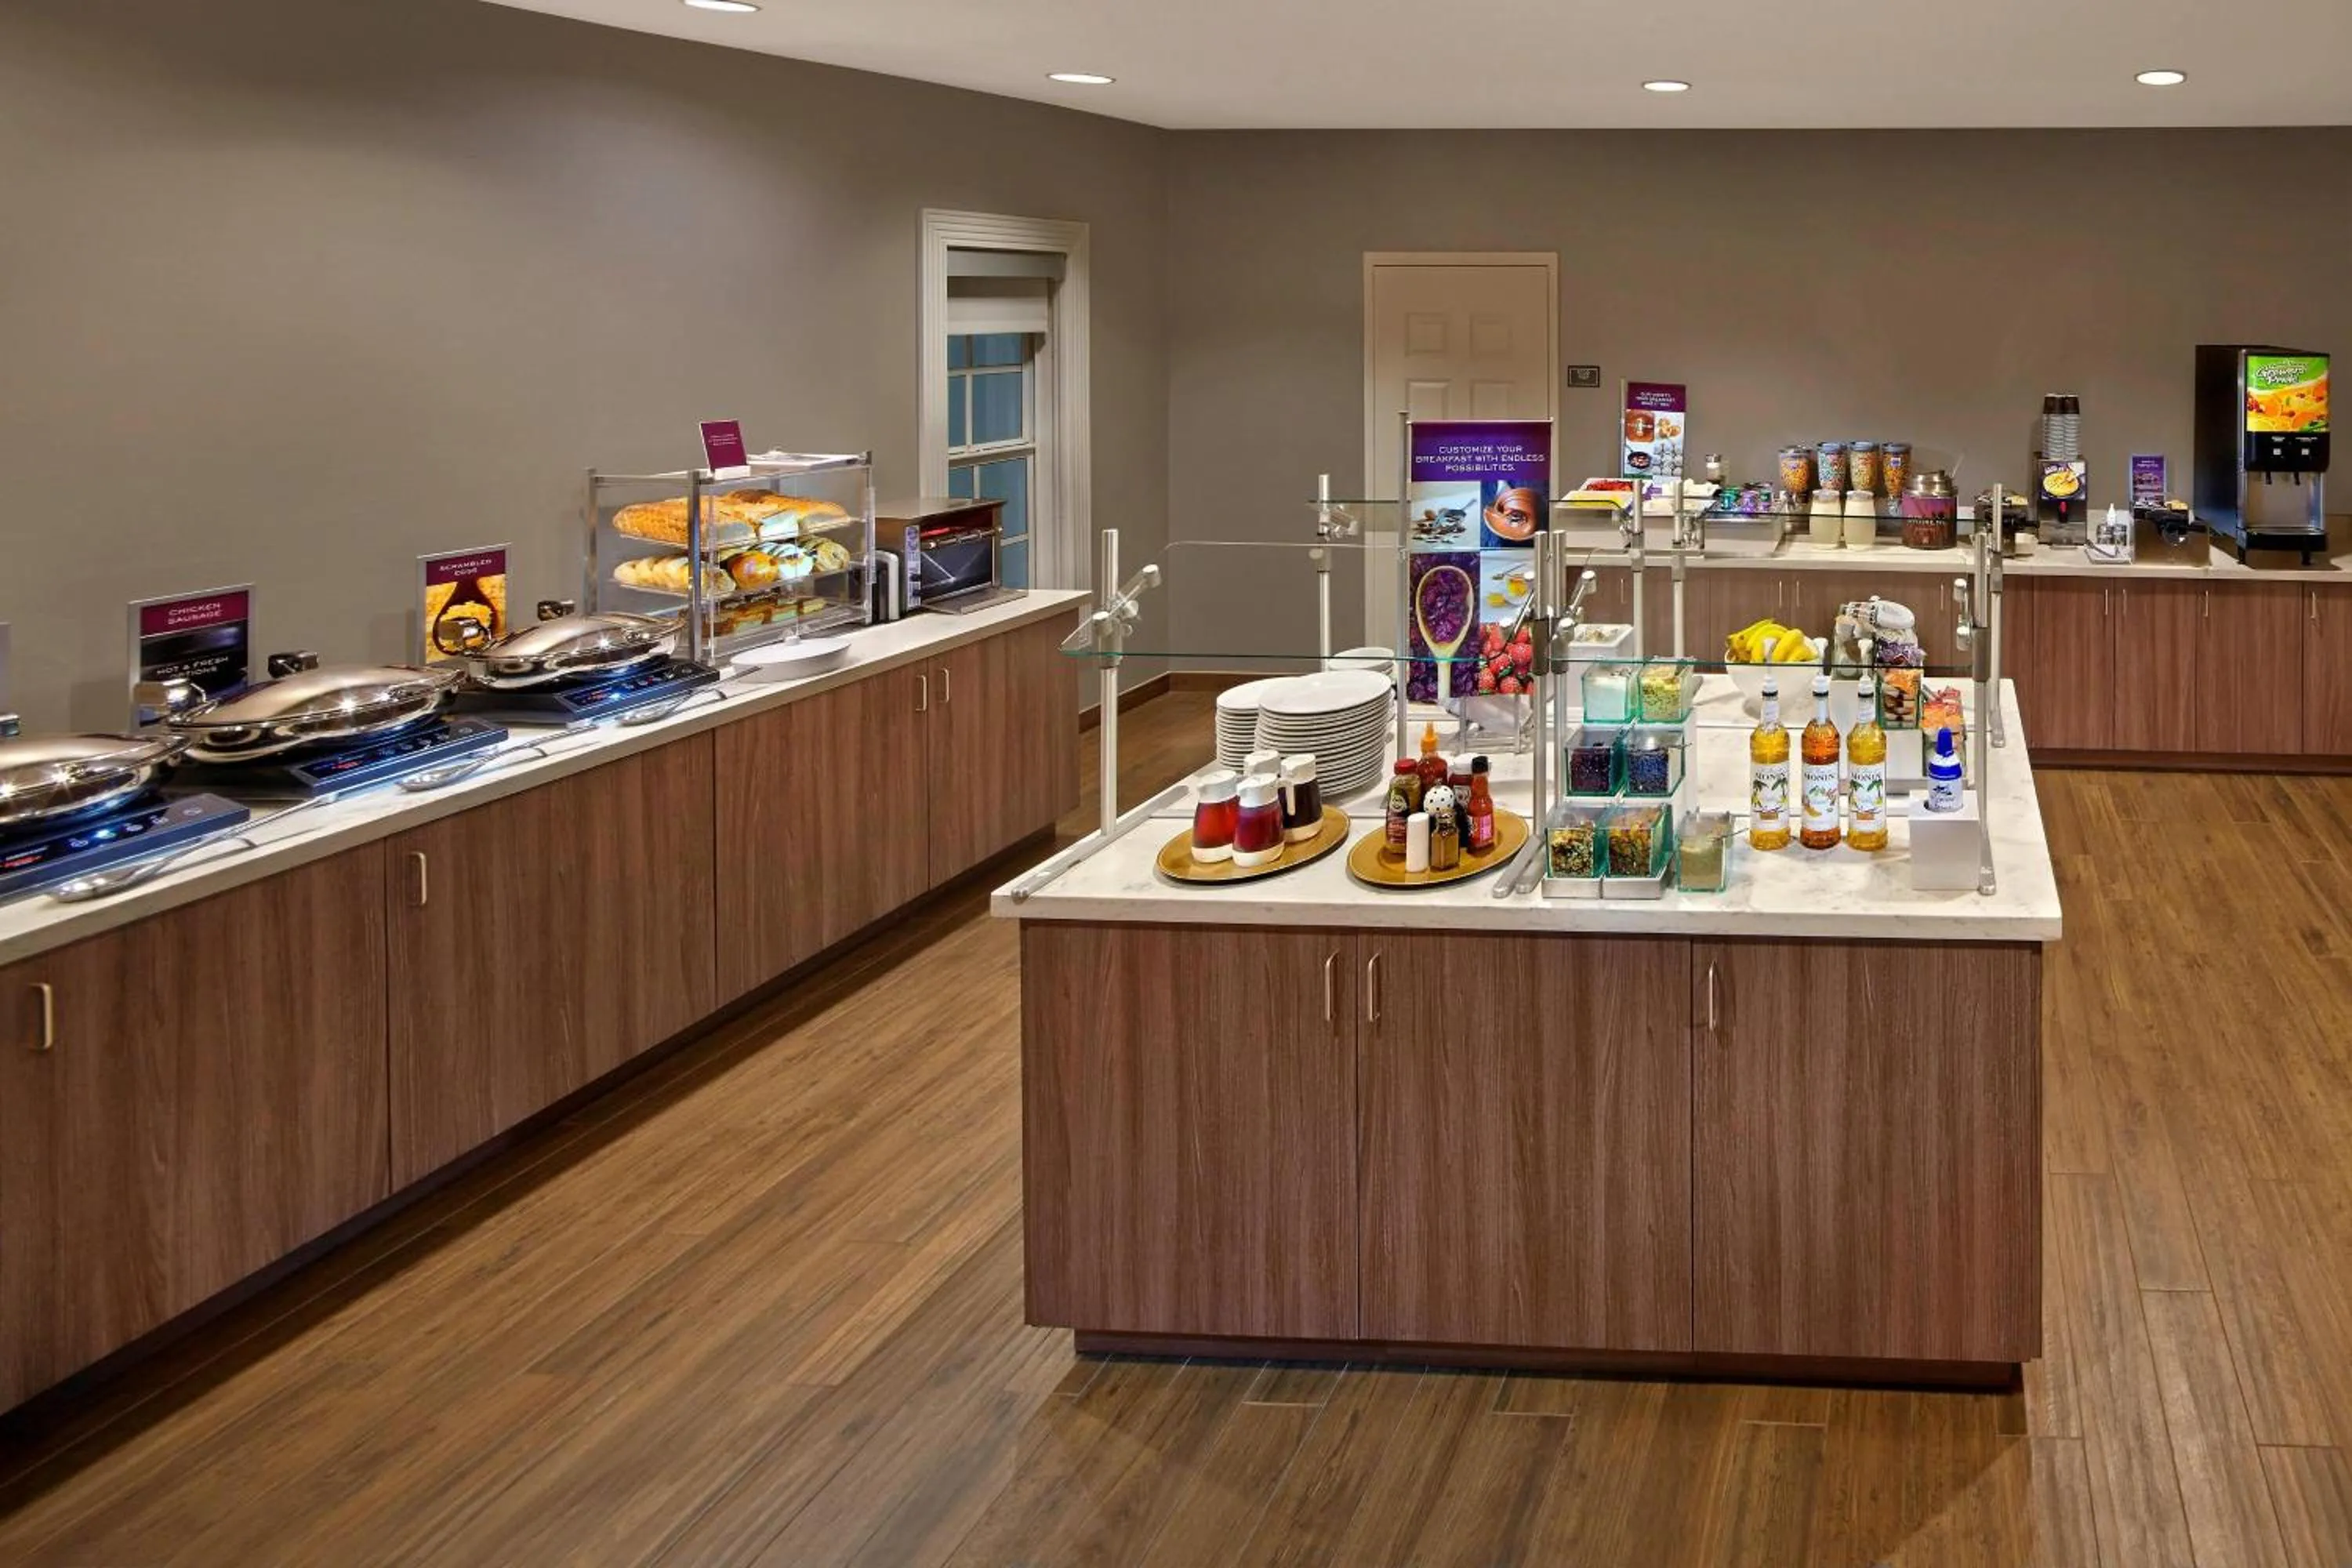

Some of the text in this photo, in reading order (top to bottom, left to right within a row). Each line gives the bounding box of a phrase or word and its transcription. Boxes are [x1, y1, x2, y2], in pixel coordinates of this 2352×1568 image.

[1439, 445, 1493, 454] CUSTOMIZE
[1415, 455, 1472, 463] BREAKFAST
[169, 602, 221, 616] CHICKEN
[168, 610, 222, 625] SAUSAGE
[157, 665, 180, 674] HOT
[193, 656, 229, 667] FRESH
[1804, 772, 1835, 782] MONIN
[1851, 772, 1881, 782] MONIN
